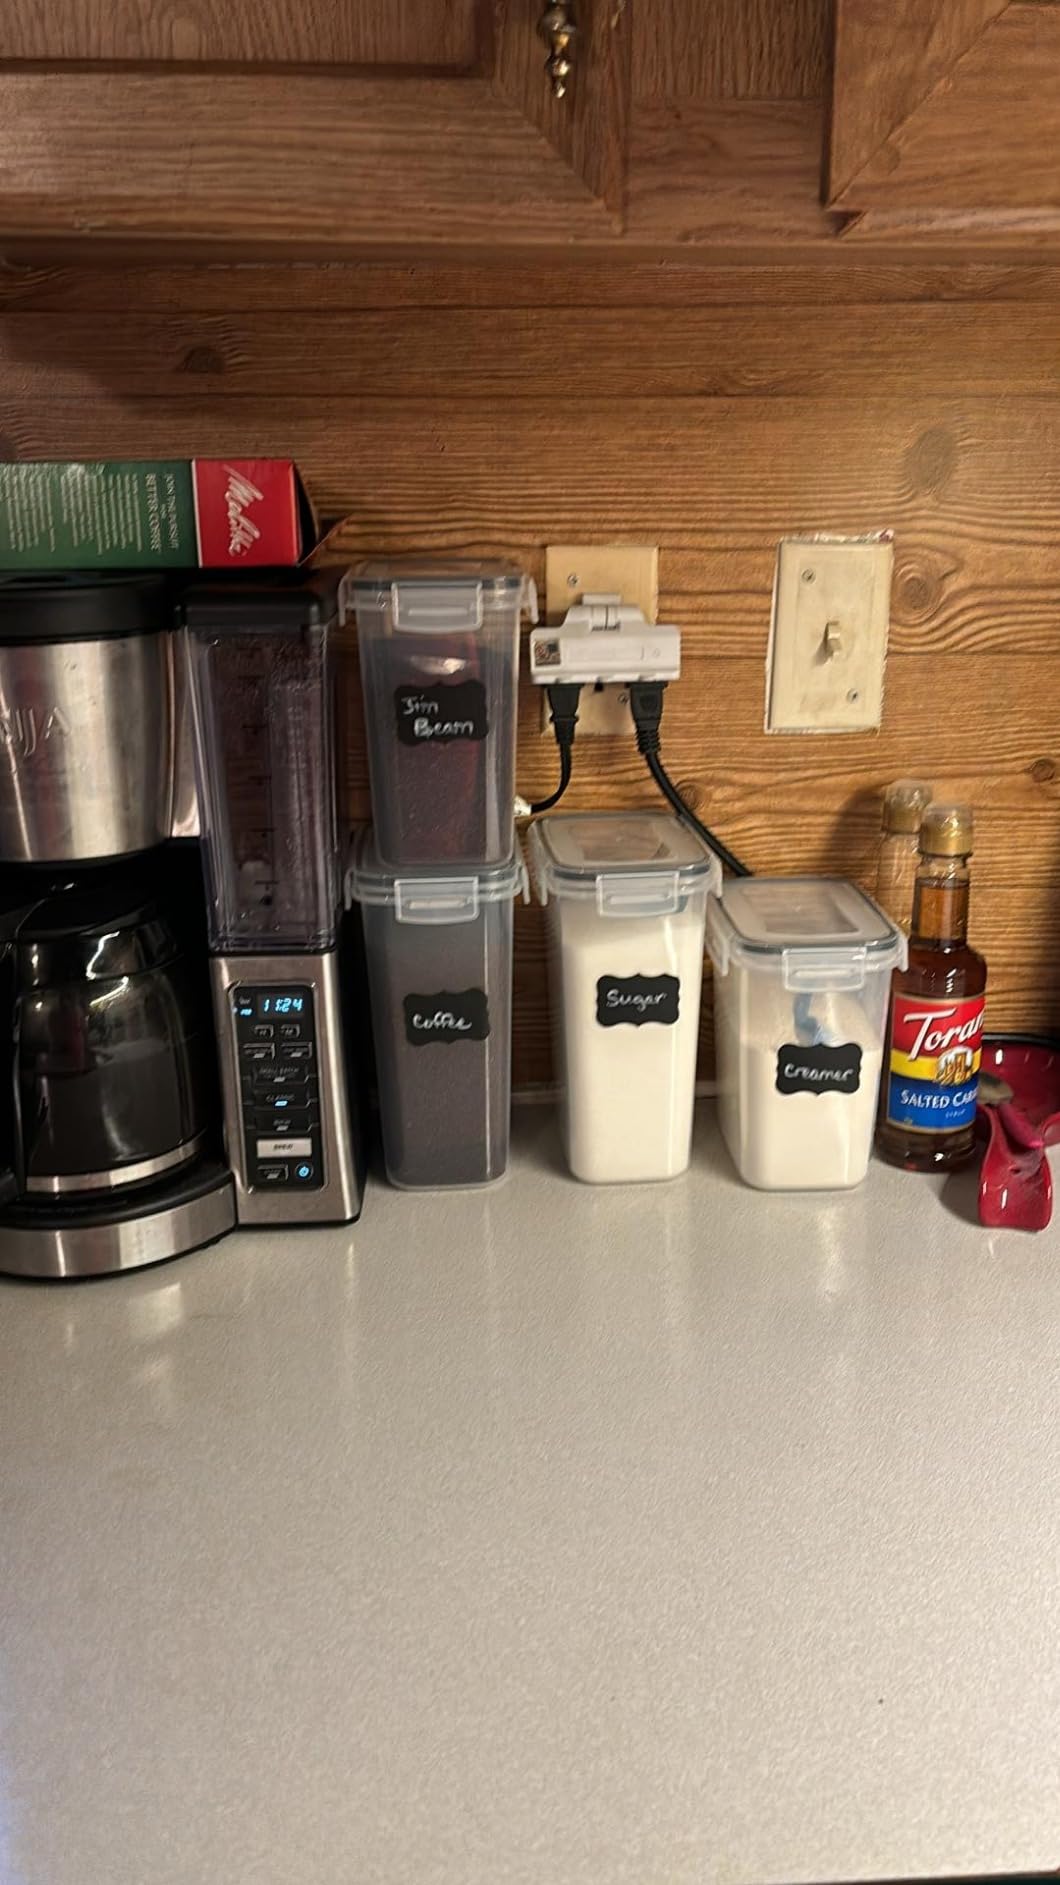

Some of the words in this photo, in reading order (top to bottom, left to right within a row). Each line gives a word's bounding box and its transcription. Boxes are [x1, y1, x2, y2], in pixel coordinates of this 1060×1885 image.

[222, 464, 264, 556] Melitta
[414, 717, 474, 738] Beam
[264, 997, 303, 1012] 11:24
[606, 988, 668, 1012] Sugar
[784, 1063, 854, 1082] Creamer
[901, 1089, 950, 1109] SALTED
